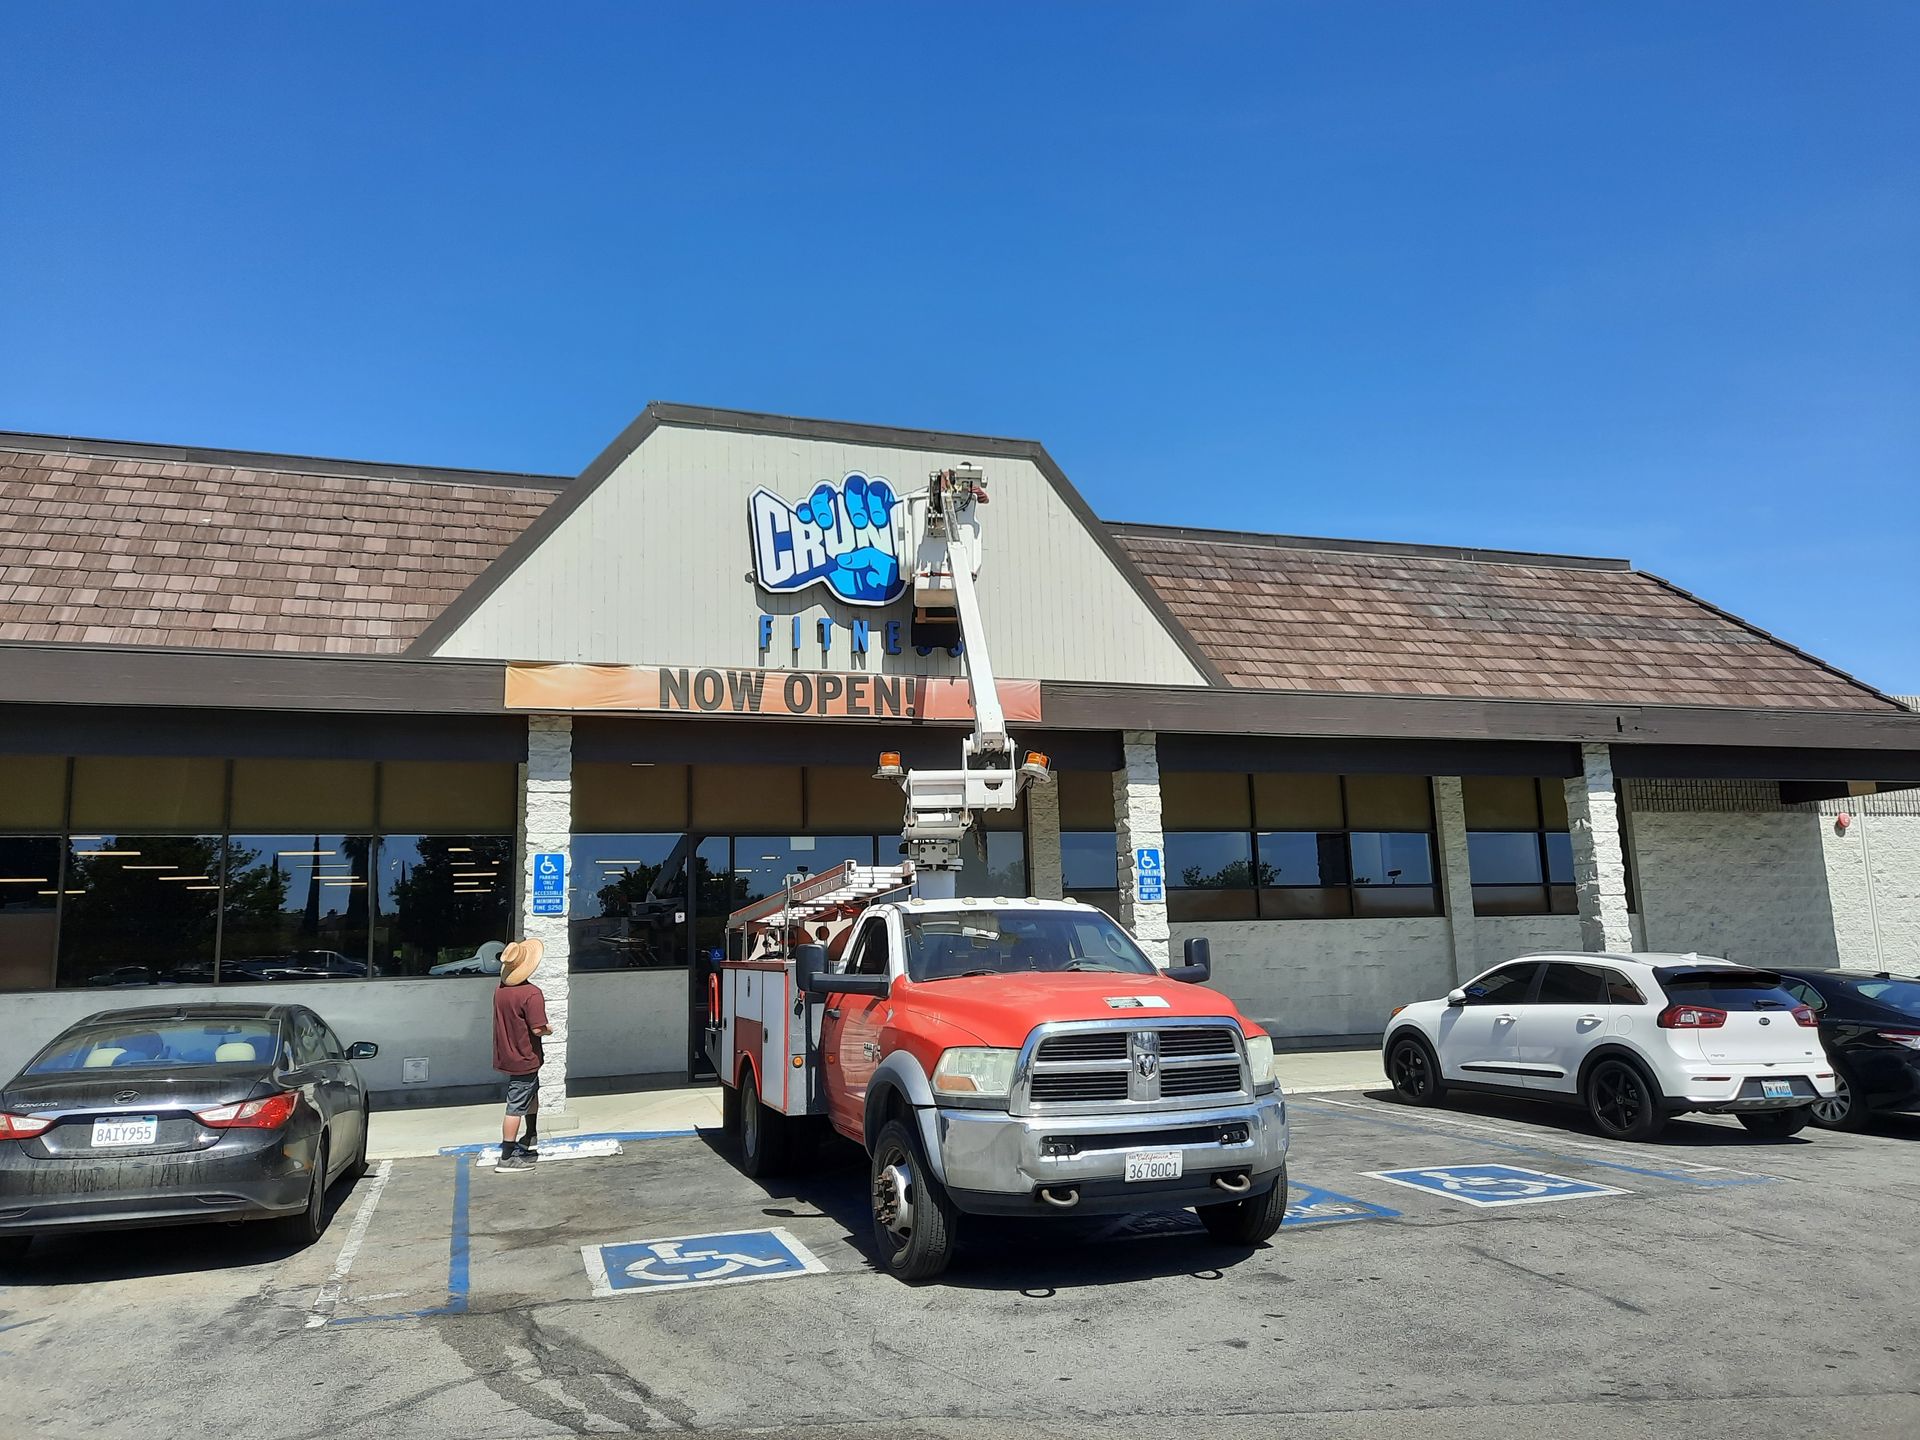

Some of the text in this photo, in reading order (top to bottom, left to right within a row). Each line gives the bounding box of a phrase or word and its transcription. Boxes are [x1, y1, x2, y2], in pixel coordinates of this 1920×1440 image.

[754, 491, 901, 586] CRUN
[759, 614, 964, 657] FITNE
[659, 668, 916, 718] NOW OPEN!
[12, 1101, 59, 1109] SONATA
[96, 1126, 152, 1142] 8AIY955
[1129, 1162, 1178, 1179] 36780C1
